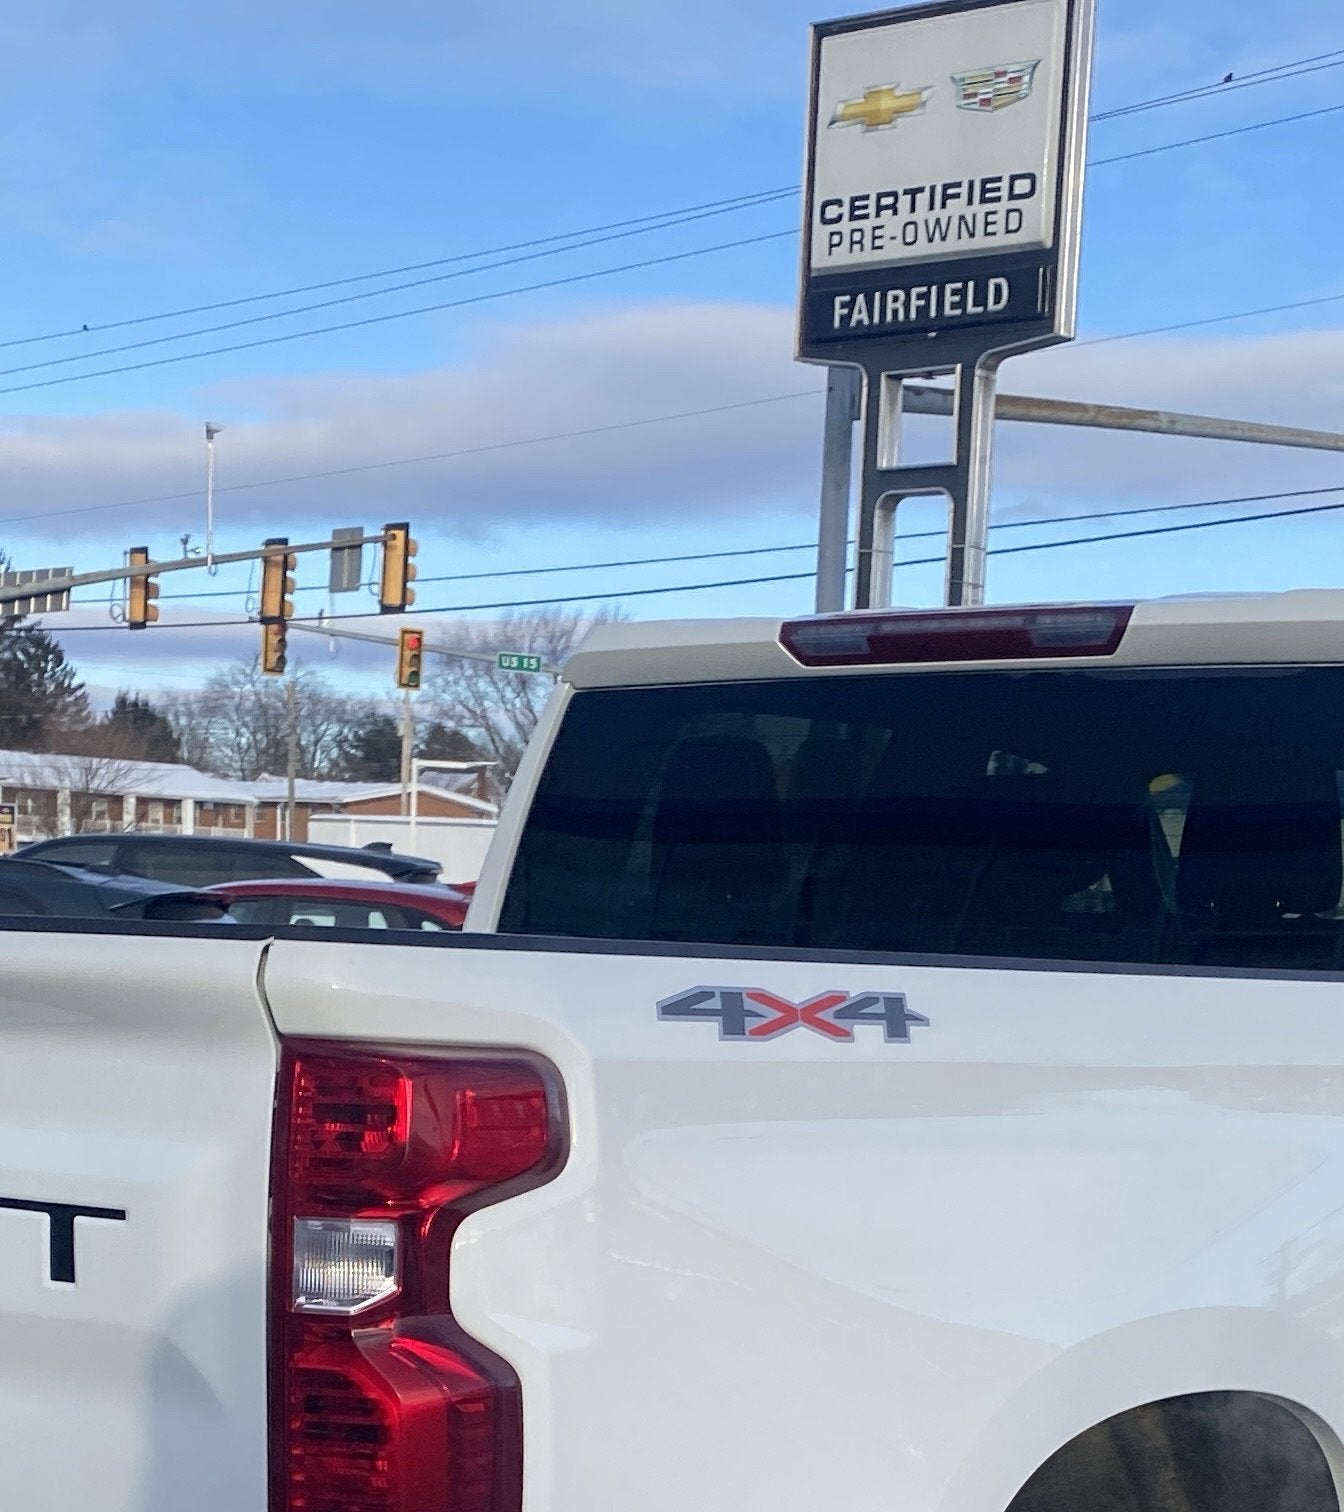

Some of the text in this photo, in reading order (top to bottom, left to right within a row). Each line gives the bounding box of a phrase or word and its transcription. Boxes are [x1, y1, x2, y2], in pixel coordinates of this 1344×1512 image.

[820, 171, 1037, 226] CERTIFIED
[828, 207, 1024, 257] PRE-OWNED
[832, 276, 1011, 330] FAIRFIELD
[501, 655, 538, 670] US 15
